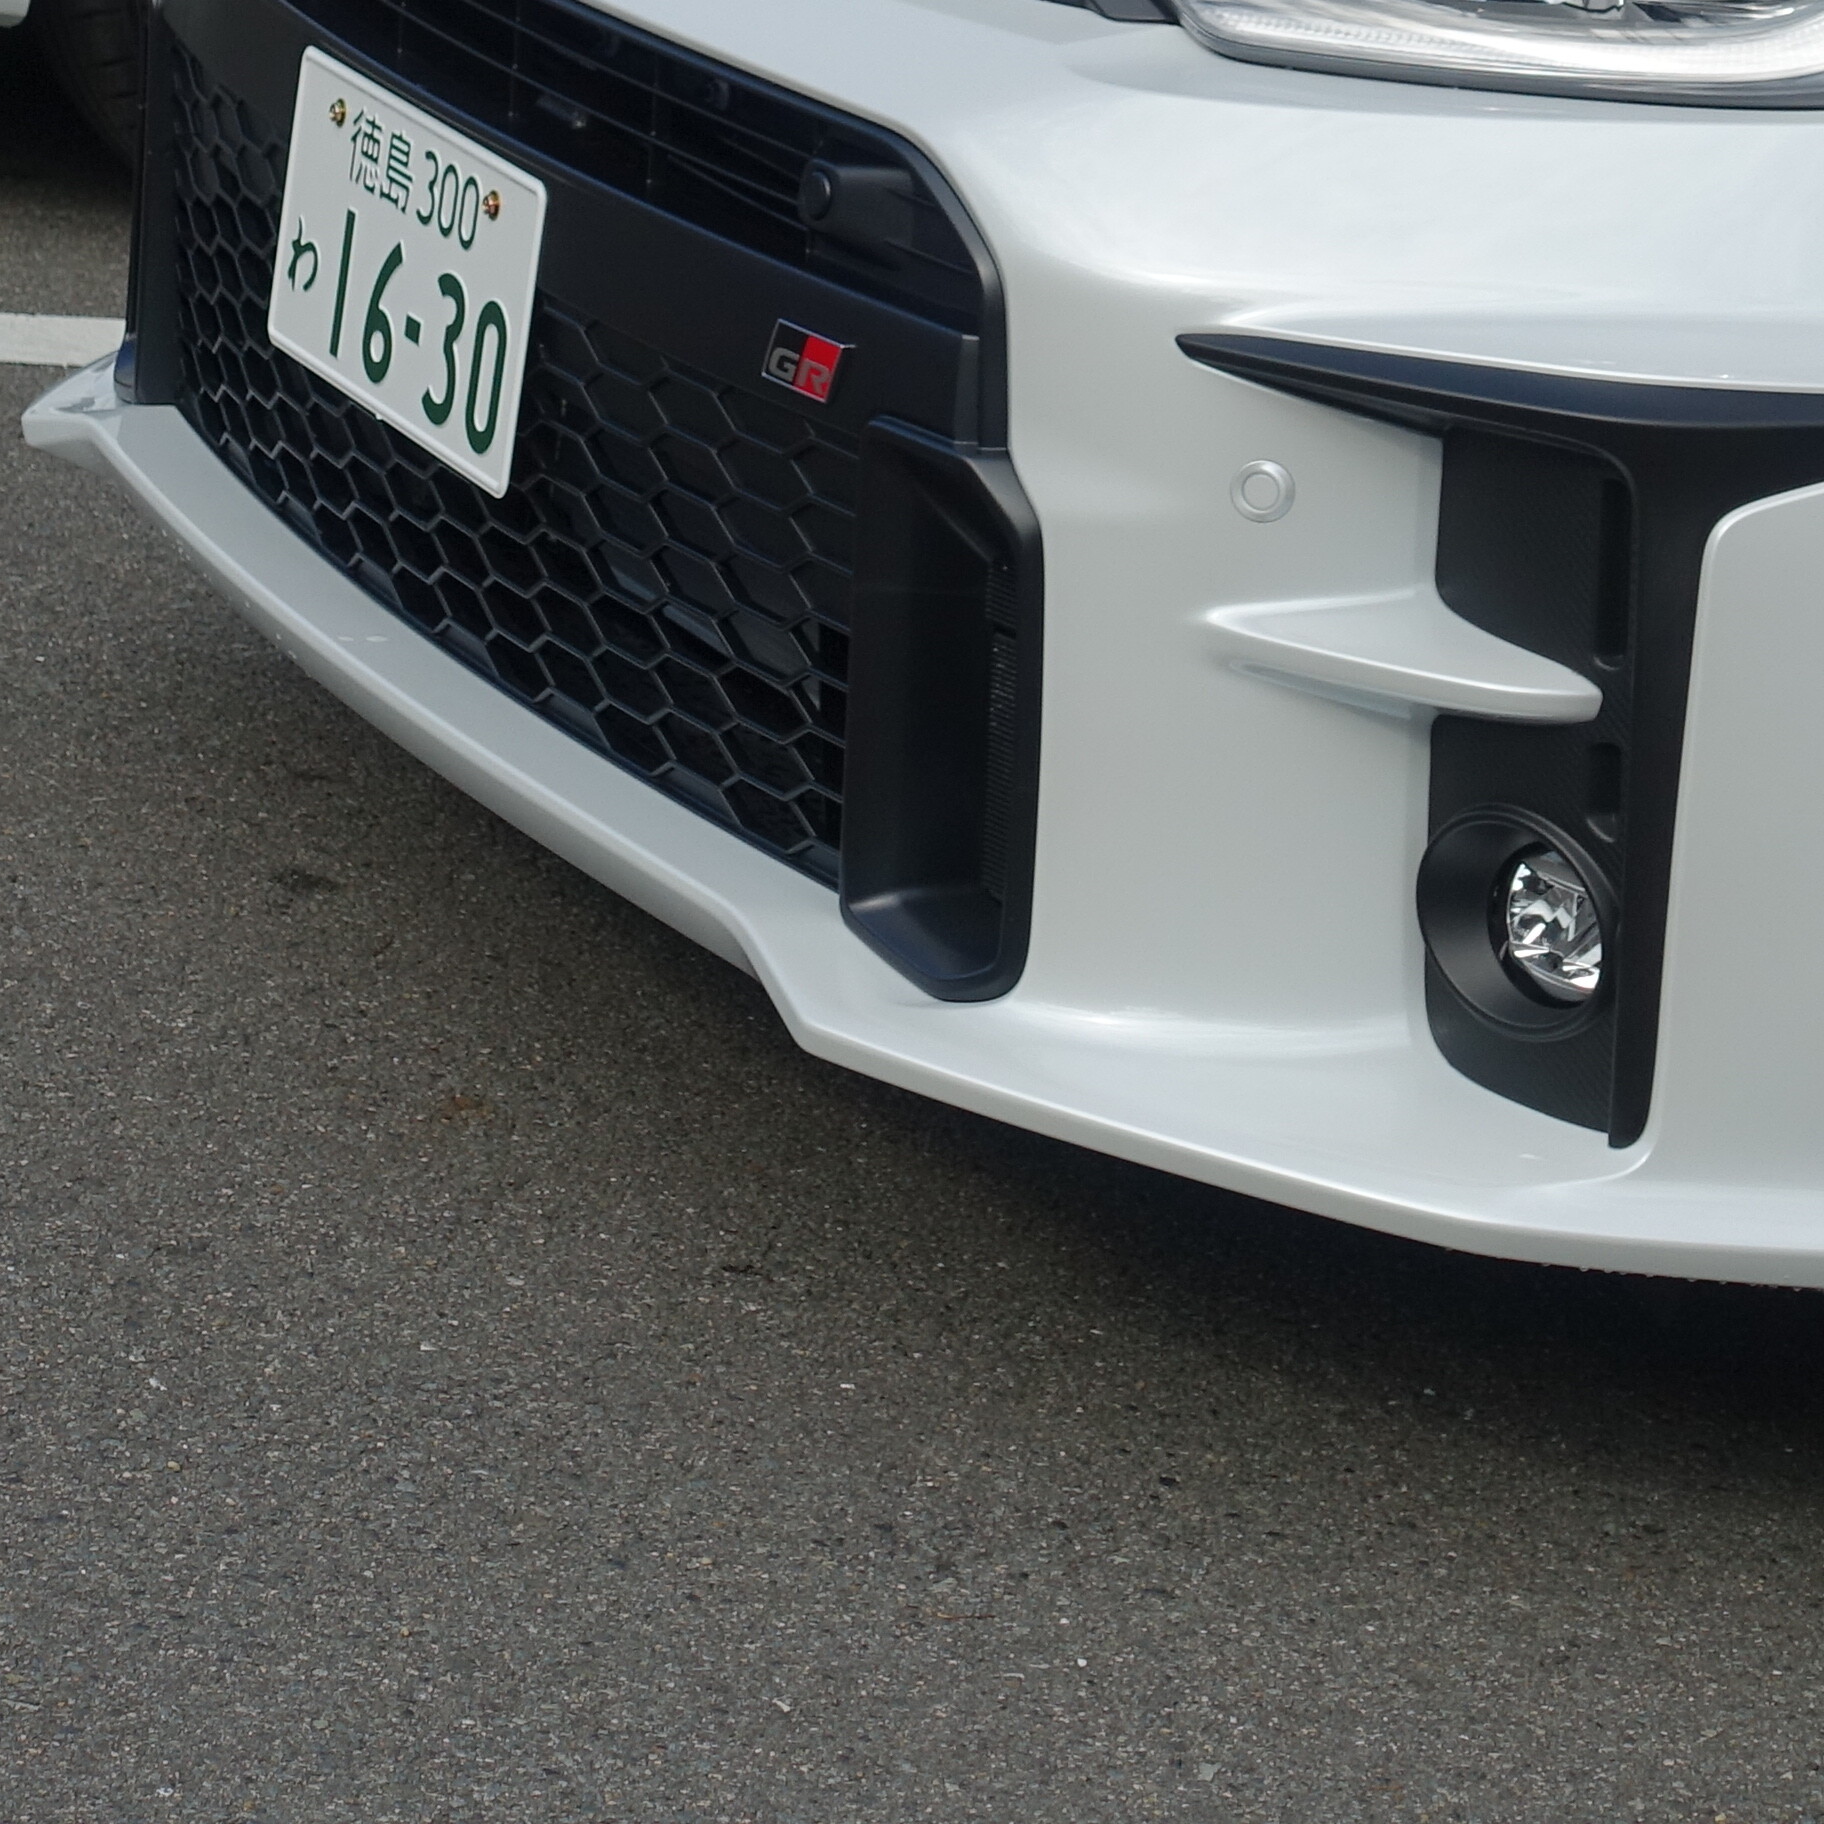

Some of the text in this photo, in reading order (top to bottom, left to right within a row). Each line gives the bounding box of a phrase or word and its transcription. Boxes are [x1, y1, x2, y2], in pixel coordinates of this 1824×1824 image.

[286, 207, 509, 456] わ 16-30
[768, 346, 832, 396] GR
